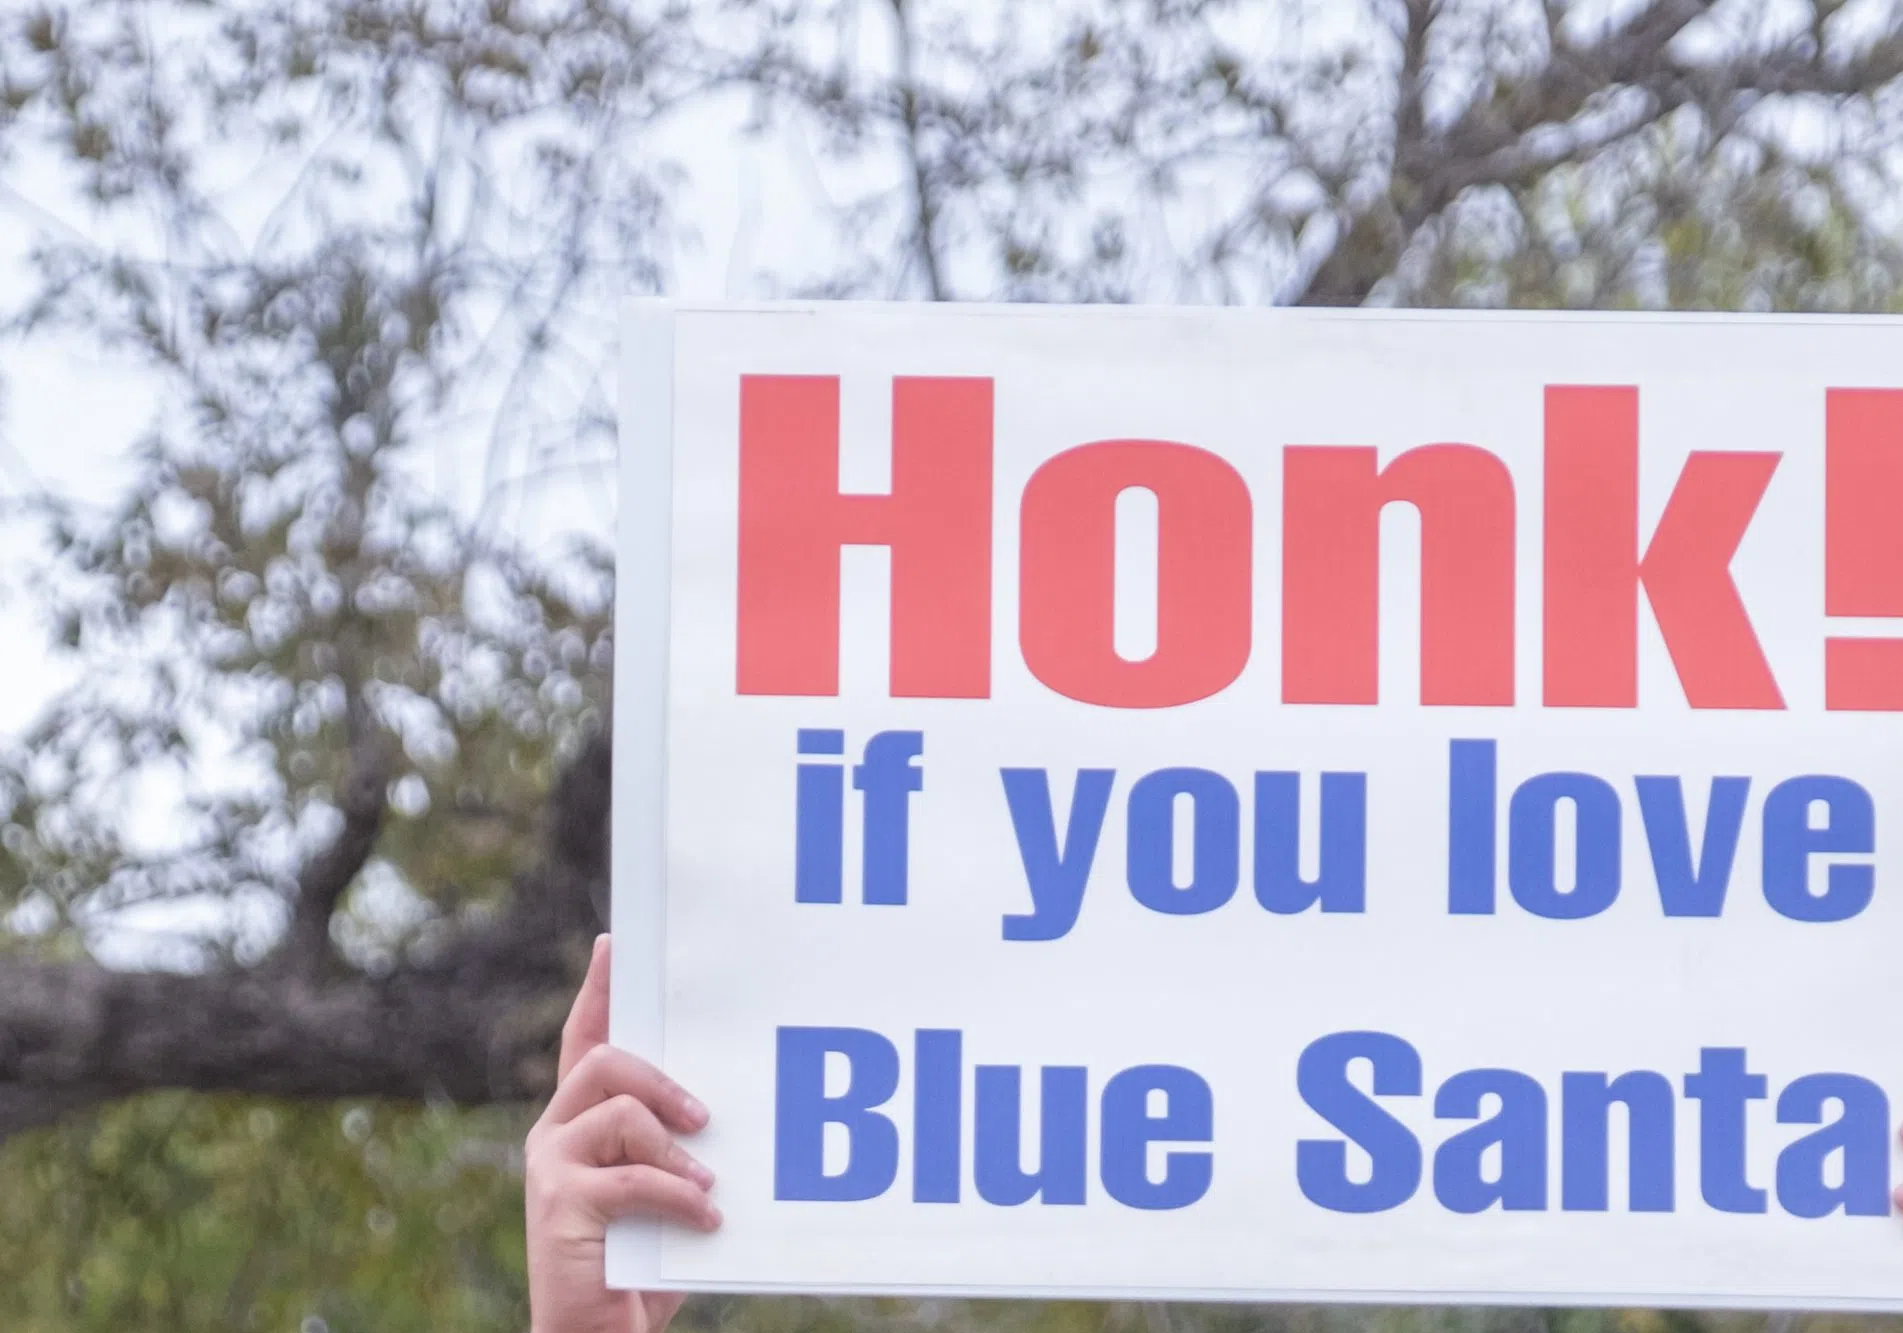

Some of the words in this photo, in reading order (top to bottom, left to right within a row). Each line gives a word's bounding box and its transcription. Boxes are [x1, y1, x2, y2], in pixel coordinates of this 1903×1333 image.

[795, 729, 924, 906] if
[1000, 767, 1367, 942] you
[1448, 739, 1876, 924] love
[774, 1026, 1213, 1211] Blue
[1296, 1031, 1891, 1219] Santa
